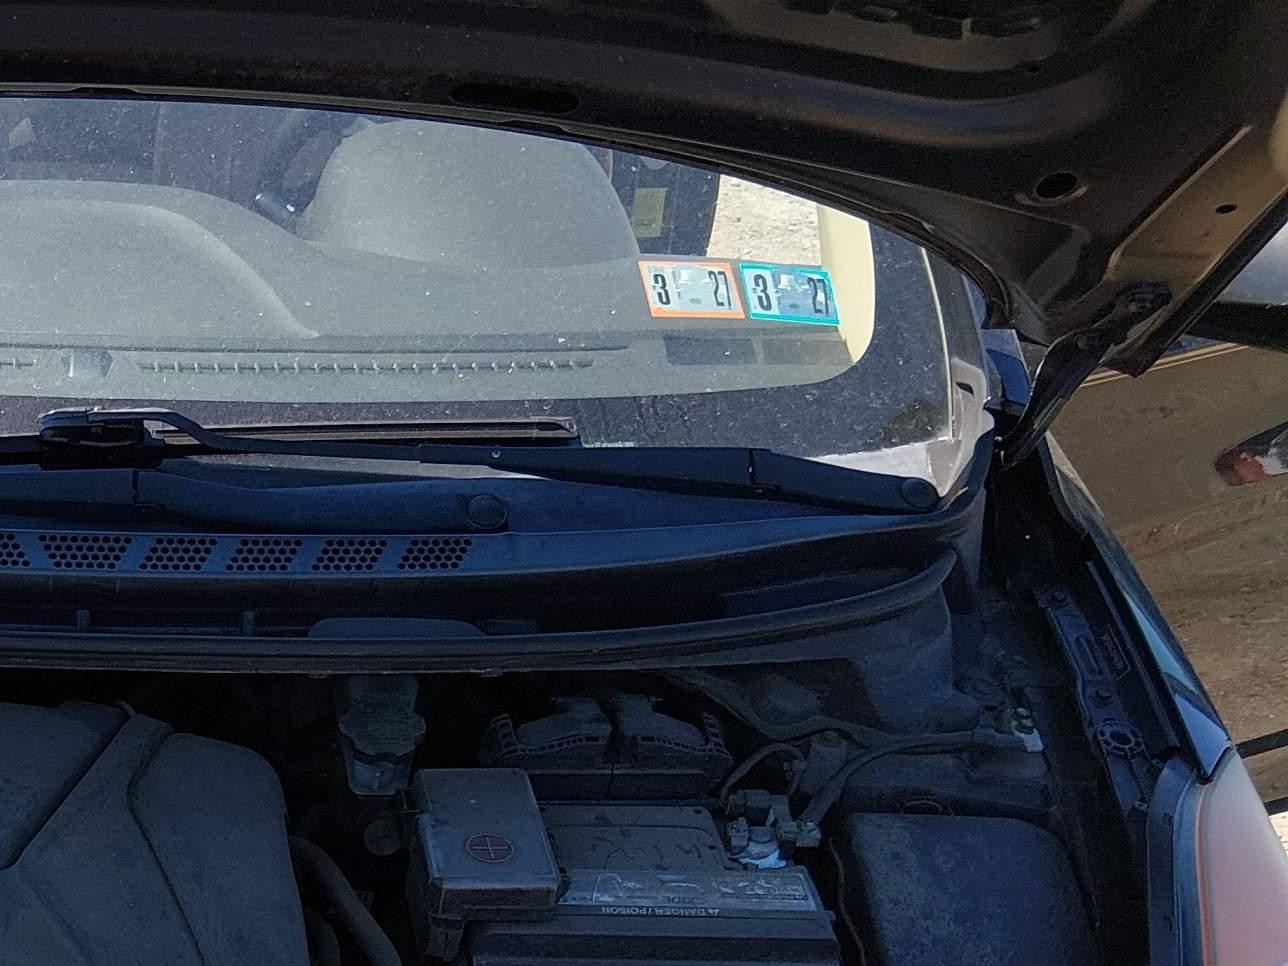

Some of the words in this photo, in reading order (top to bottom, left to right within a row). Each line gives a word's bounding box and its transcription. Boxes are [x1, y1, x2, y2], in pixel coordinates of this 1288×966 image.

[652, 273, 671, 306] 3
[708, 270, 732, 310] 27
[753, 273, 772, 312] 3
[807, 276, 830, 317] 27
